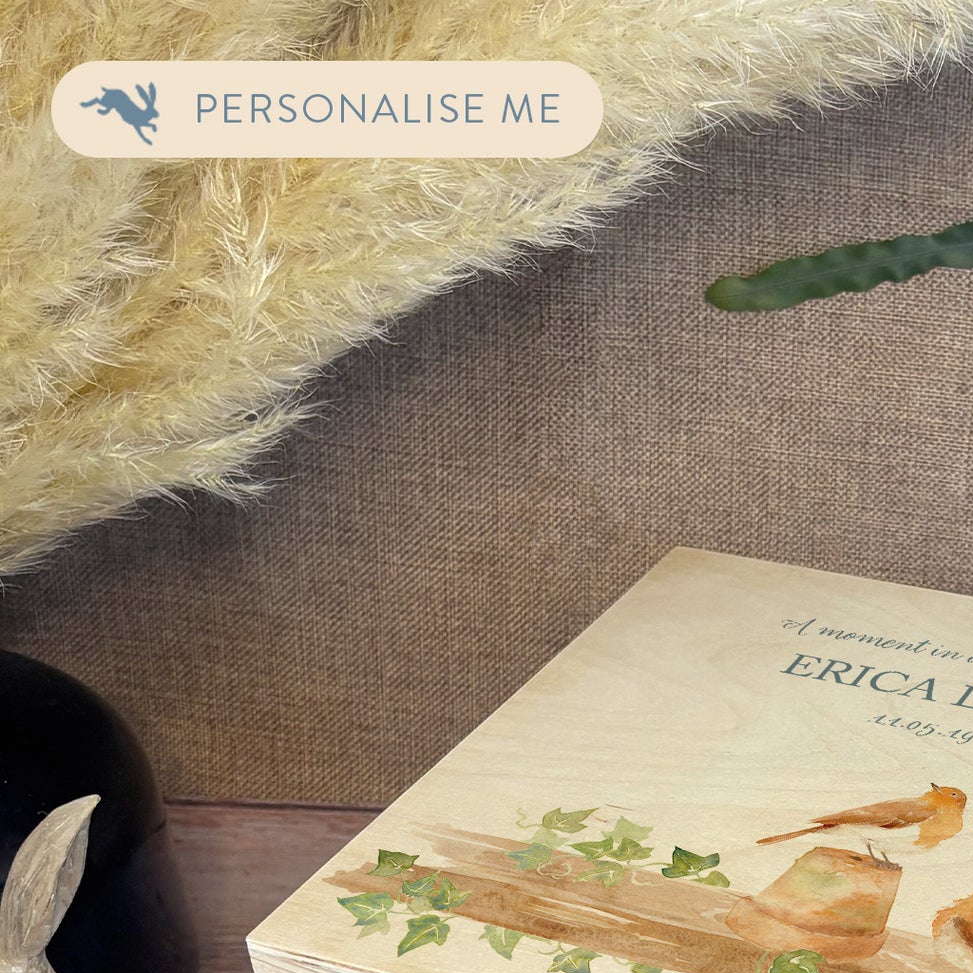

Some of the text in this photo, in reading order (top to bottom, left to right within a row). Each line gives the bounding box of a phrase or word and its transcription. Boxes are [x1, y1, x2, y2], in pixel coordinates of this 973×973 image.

[781, 618, 817, 636] A
[819, 626, 928, 654] moment
[930, 644, 963, 661] in
[779, 653, 937, 702] ERICA
